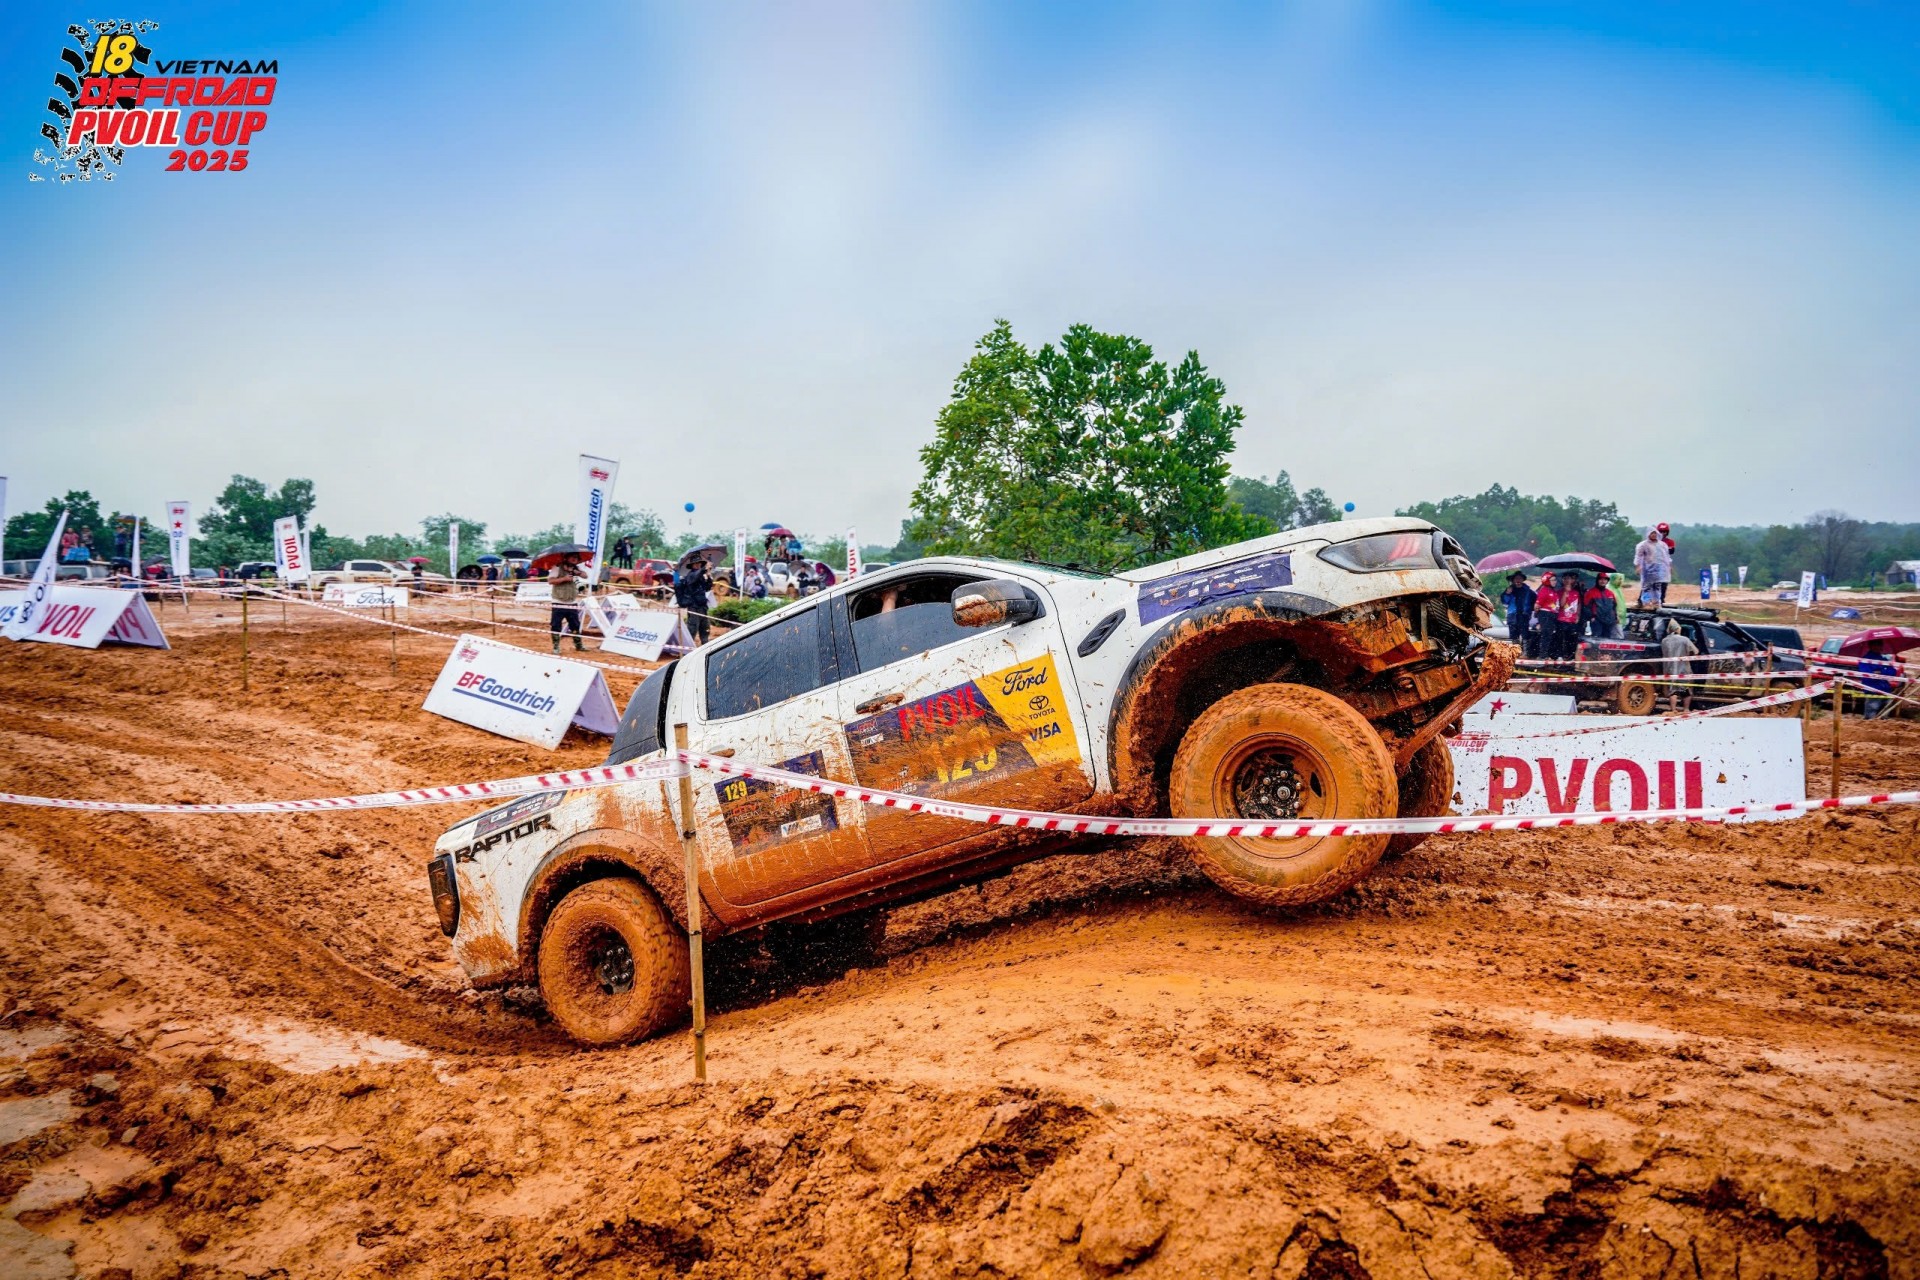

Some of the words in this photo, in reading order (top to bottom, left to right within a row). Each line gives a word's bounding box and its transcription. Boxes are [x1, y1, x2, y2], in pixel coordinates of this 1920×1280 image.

[284, 535, 301, 570] PVOIL
[356, 591, 395, 604] Ford
[617, 626, 658, 642] BFGoodrich
[456, 671, 556, 712] BFGoodrich
[1002, 666, 1048, 695] Ford
[898, 685, 985, 742] PVOIL
[1029, 708, 1056, 720] TOYOTA
[1029, 722, 1061, 742] VISA
[724, 780, 748, 801] 129
[455, 813, 558, 864] RAPTOR
